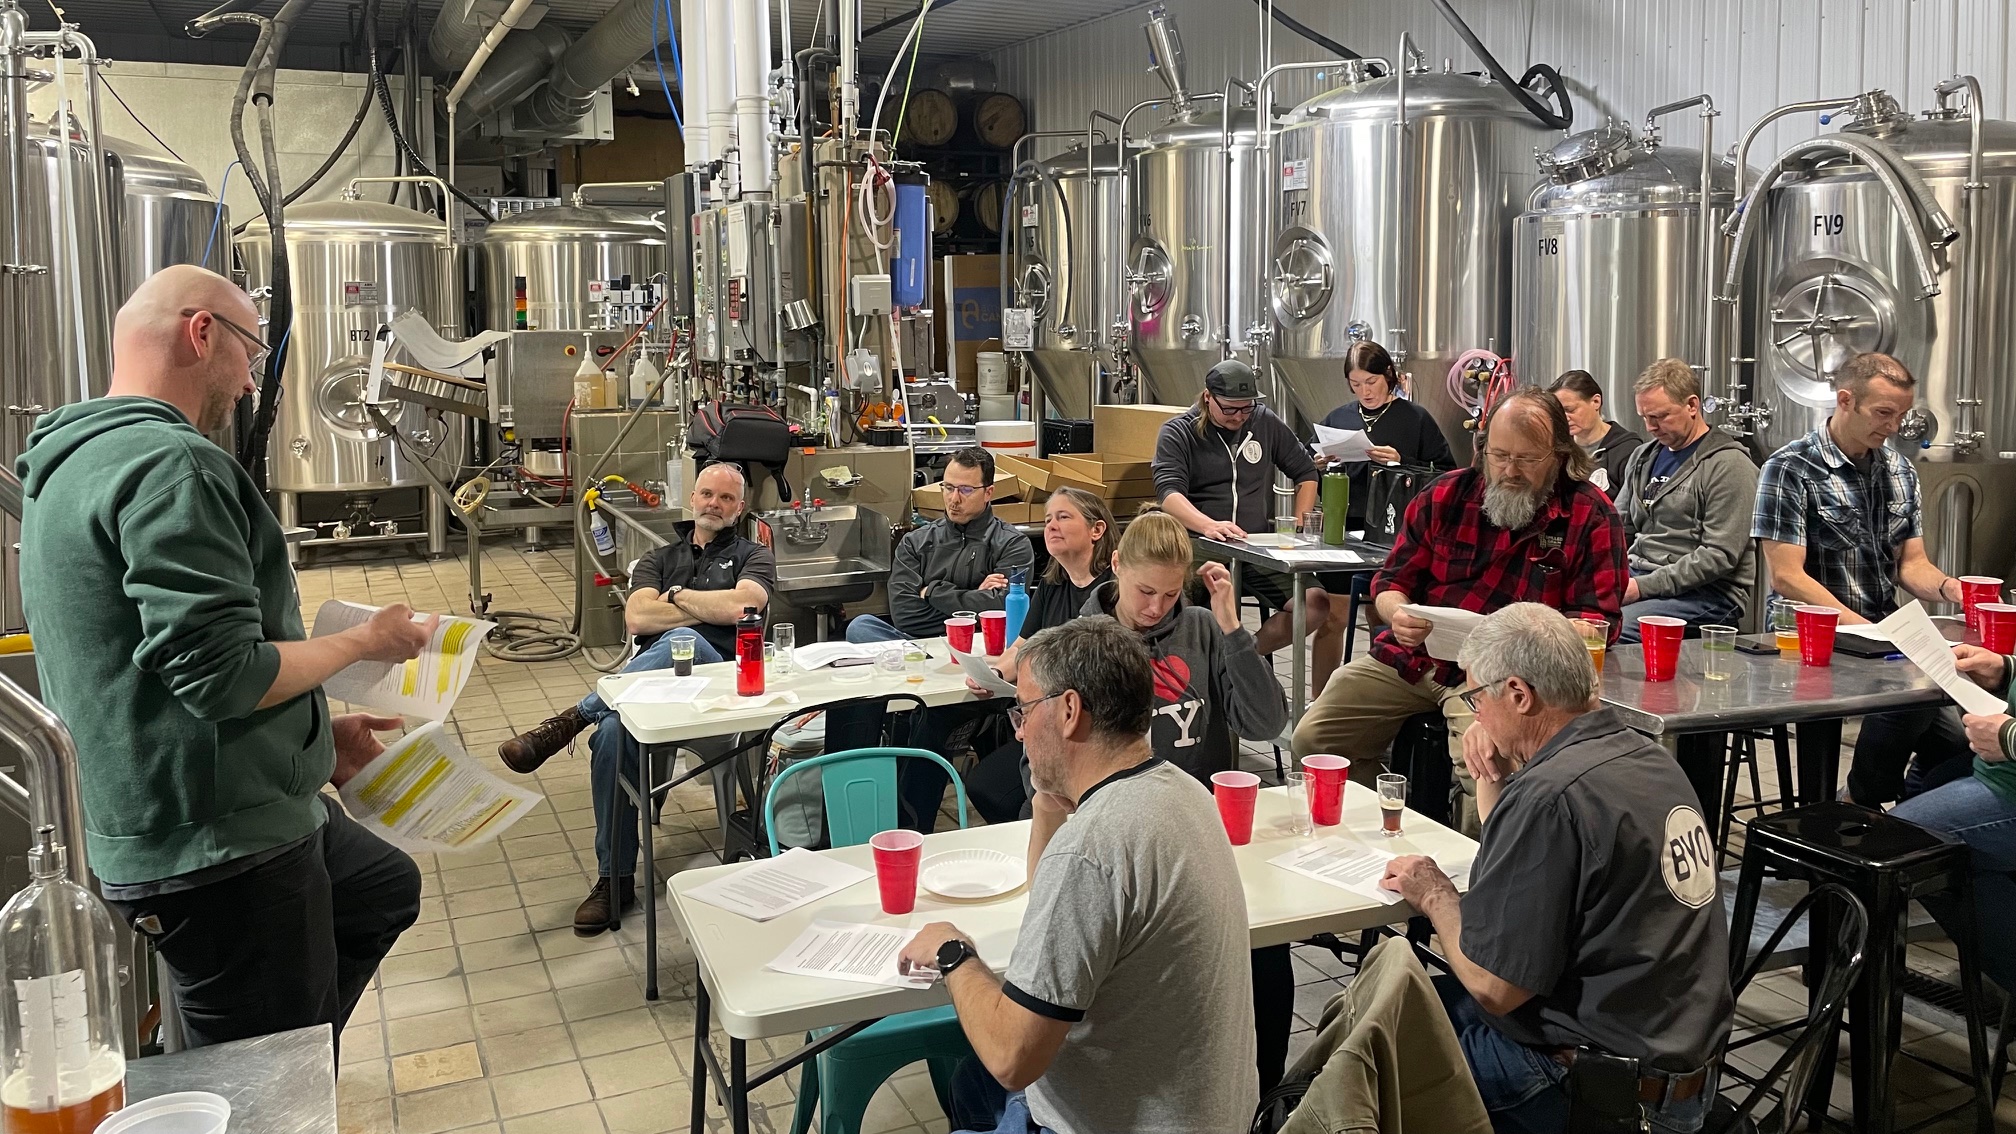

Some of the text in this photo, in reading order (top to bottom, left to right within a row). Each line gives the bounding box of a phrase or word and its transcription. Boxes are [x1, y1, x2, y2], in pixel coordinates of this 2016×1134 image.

[1291, 201, 1306, 217] FV7
[1814, 214, 1844, 236] FV9
[1539, 238, 1558, 256] FV8
[350, 329, 370, 341] BT2
[1152, 699, 1202, 747] Y
[1670, 825, 1710, 882] BYO
